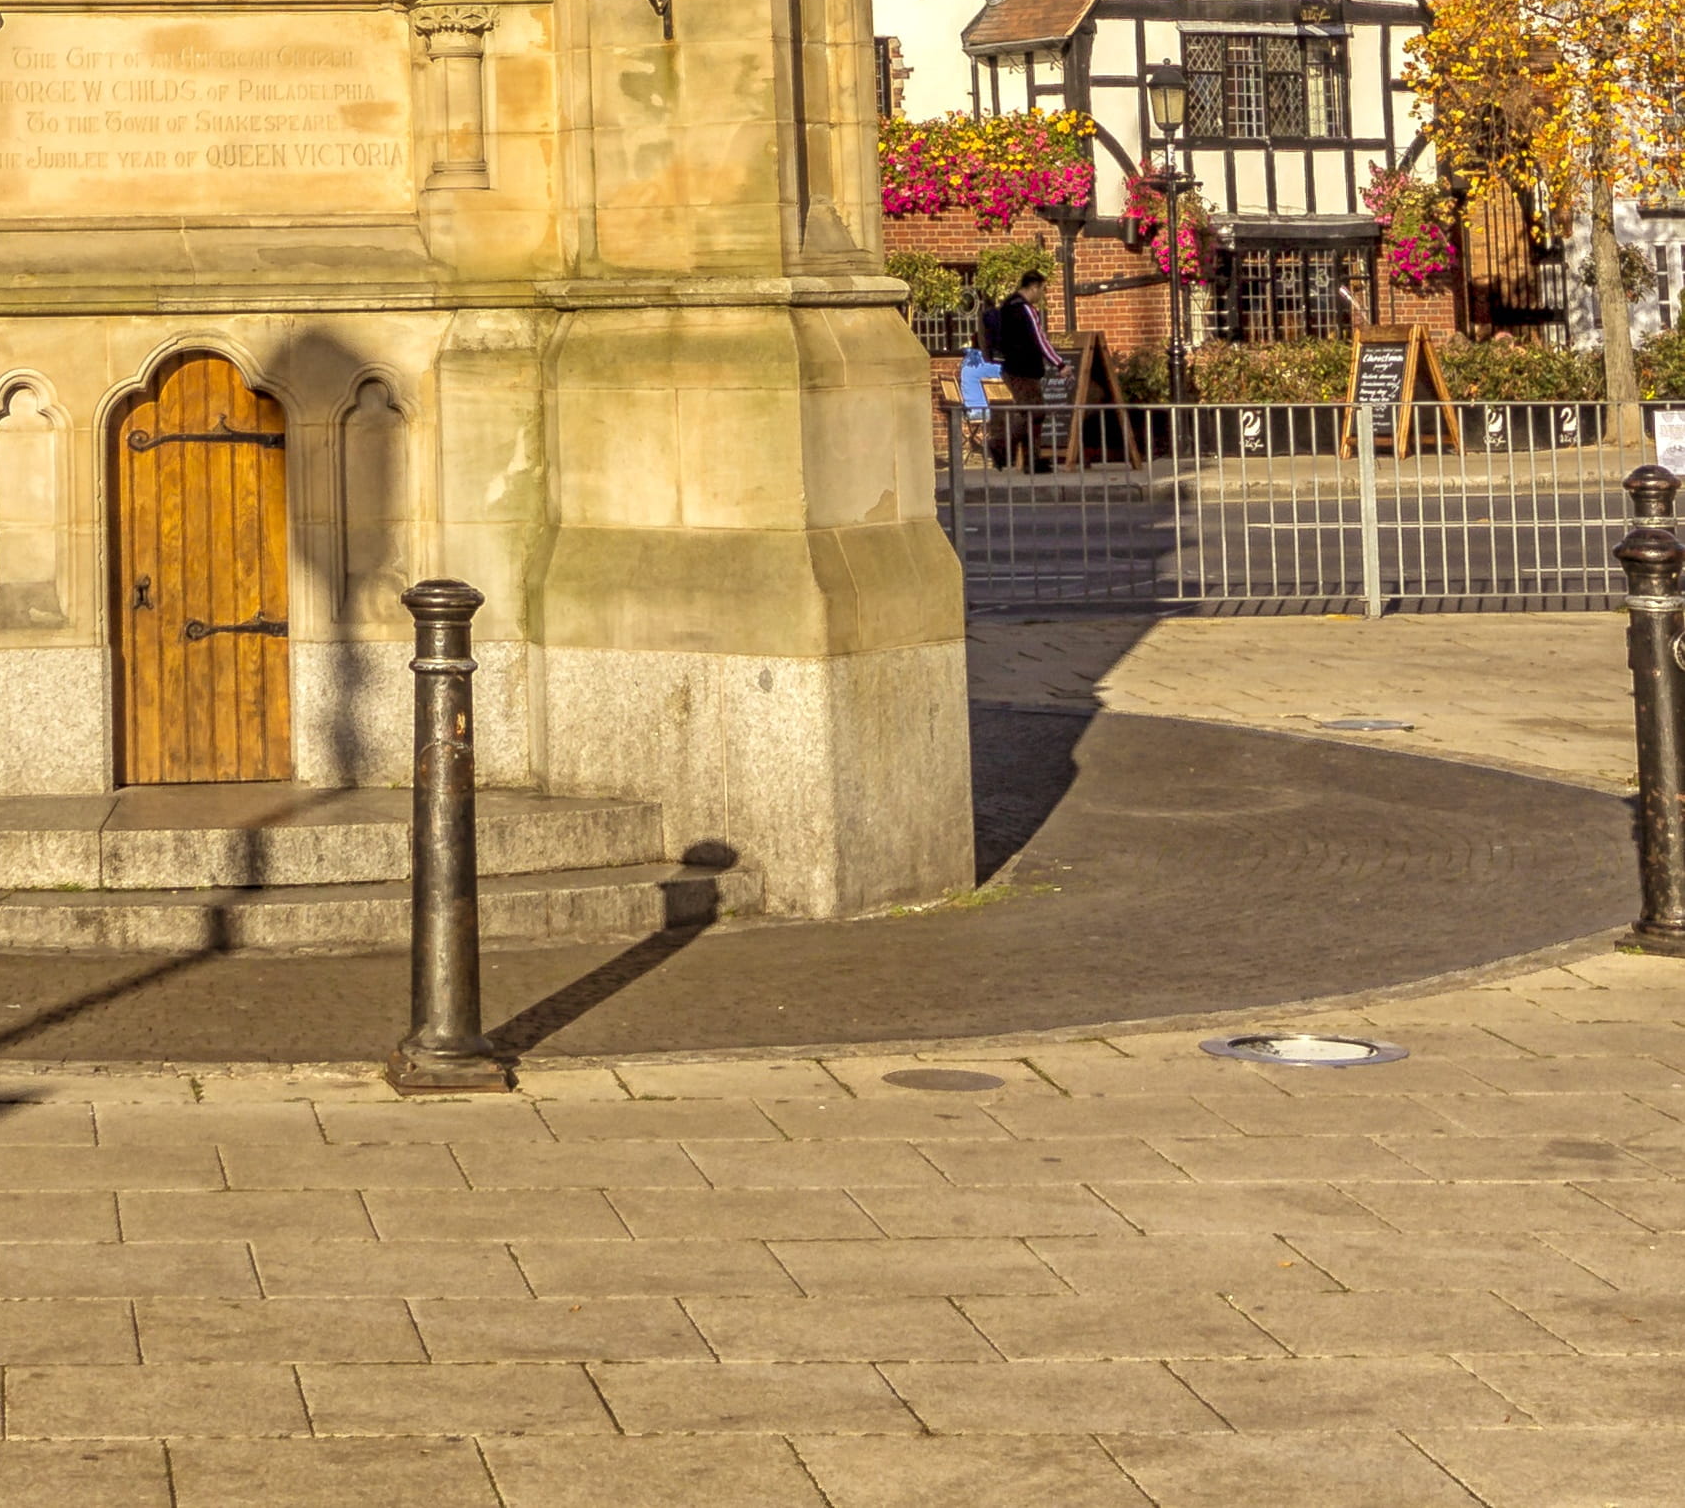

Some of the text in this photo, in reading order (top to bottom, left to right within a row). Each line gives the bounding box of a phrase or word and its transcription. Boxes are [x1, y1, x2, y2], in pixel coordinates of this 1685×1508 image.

[206, 84, 229, 102] OF
[238, 79, 376, 102] PHILADELPHIA
[65, 116, 99, 134] THE
[105, 111, 159, 134] TOWN
[195, 109, 338, 133] SHAKESPEARE
[27, 146, 109, 169] JUBILEE
[118, 152, 167, 168] YEAR
[206, 143, 287, 169] QUEEN
[294, 142, 403, 169] VICTORIA
